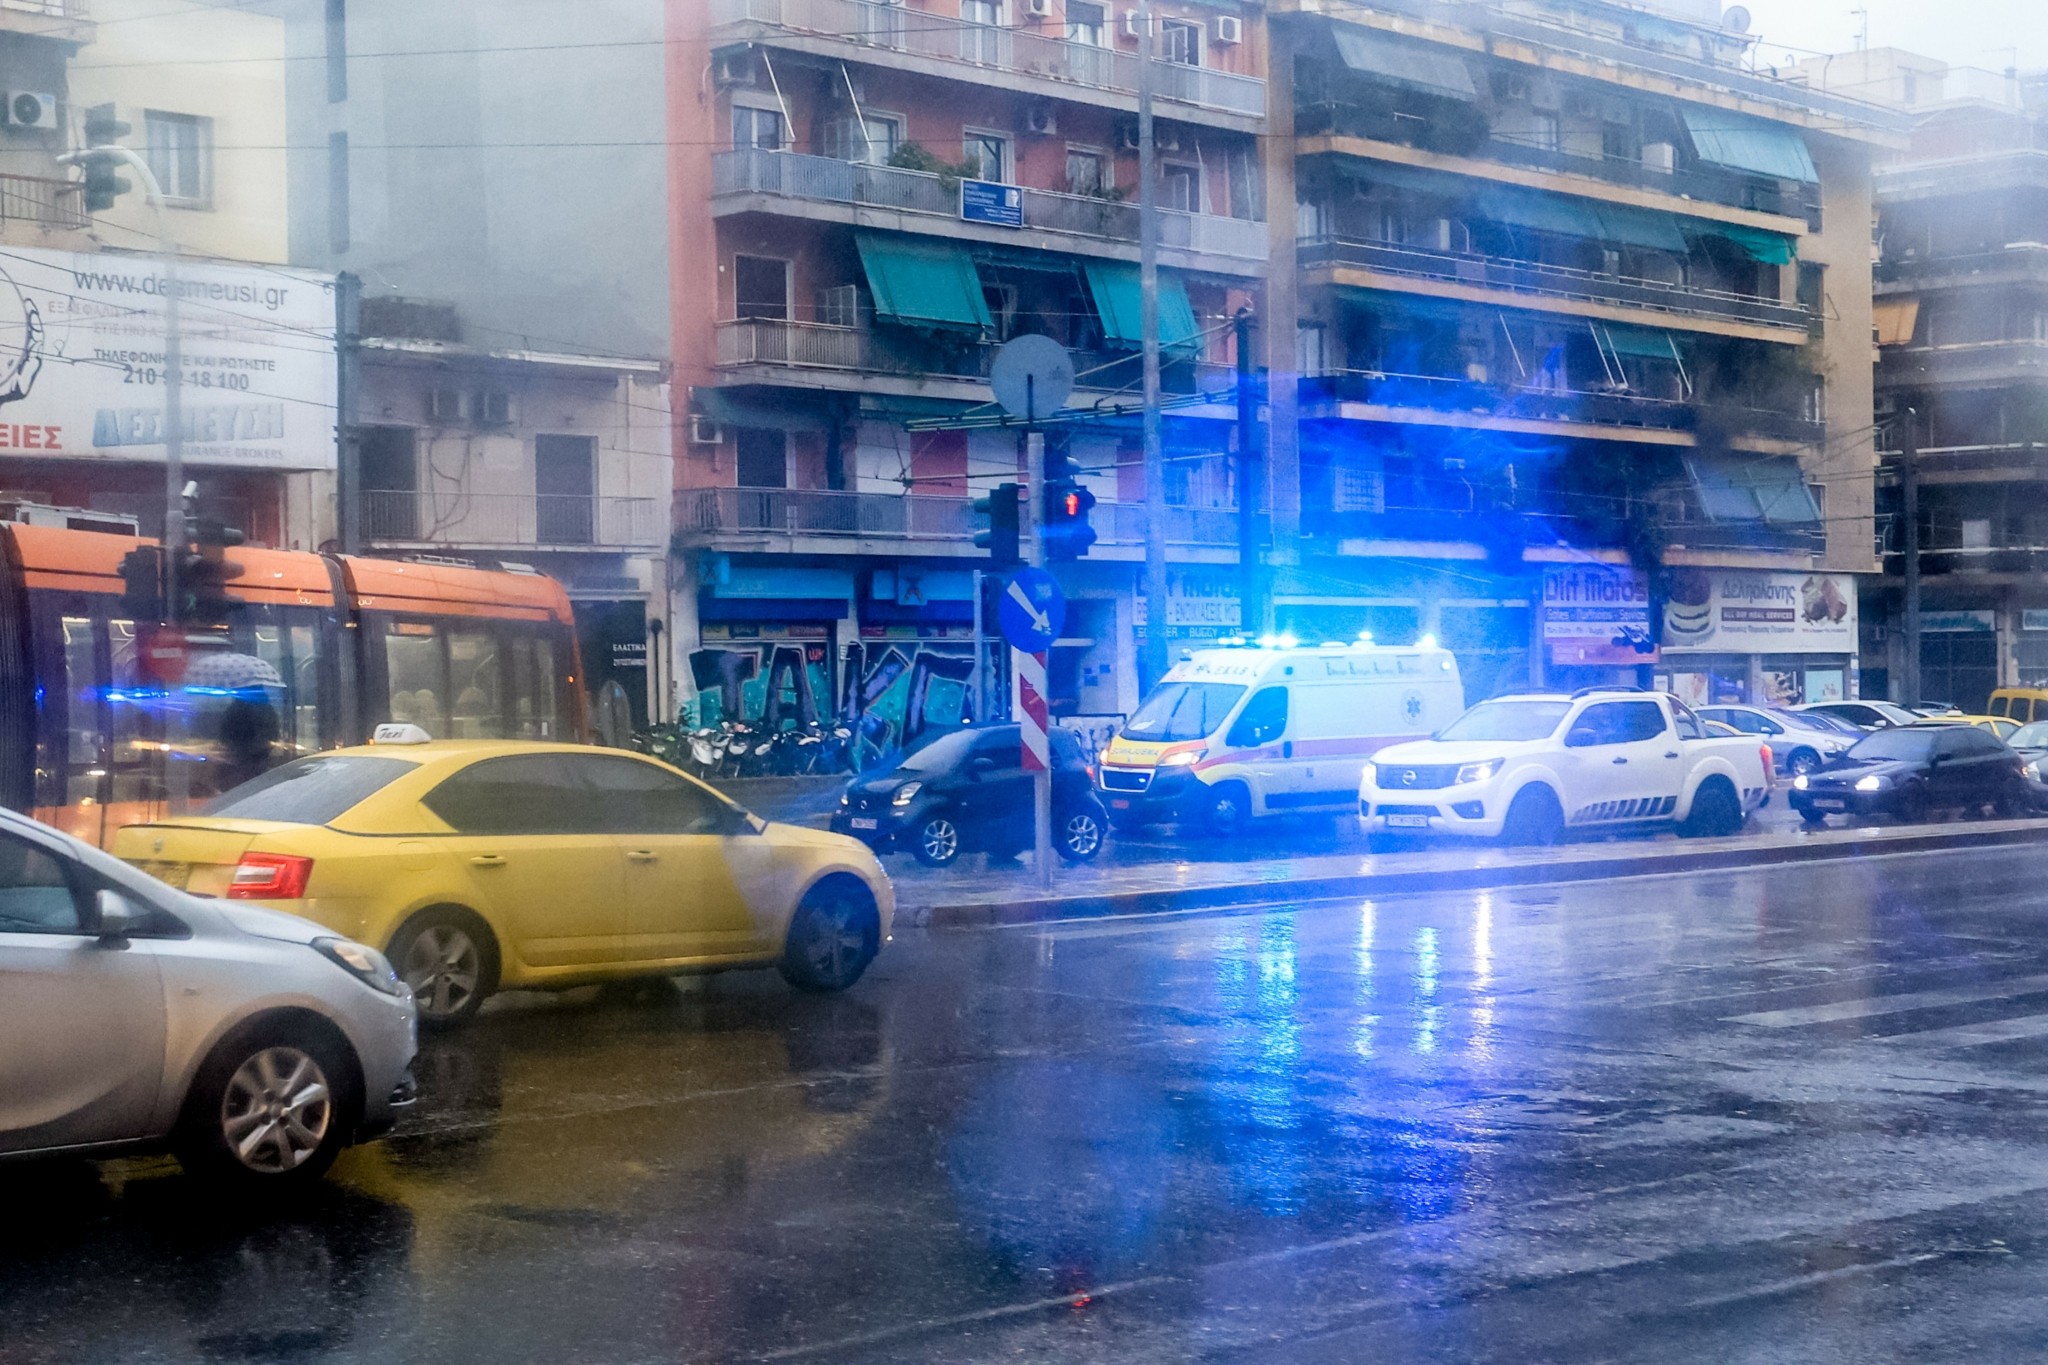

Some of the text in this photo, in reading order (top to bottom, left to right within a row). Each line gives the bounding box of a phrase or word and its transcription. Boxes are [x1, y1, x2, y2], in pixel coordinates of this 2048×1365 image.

[194, 355, 215, 367] ΚΑΙ
[219, 356, 276, 372] ΡΩΤΗΣΤΕ
[123, 367, 157, 385] 210
[190, 371, 212, 388] 18
[218, 372, 250, 390] 100
